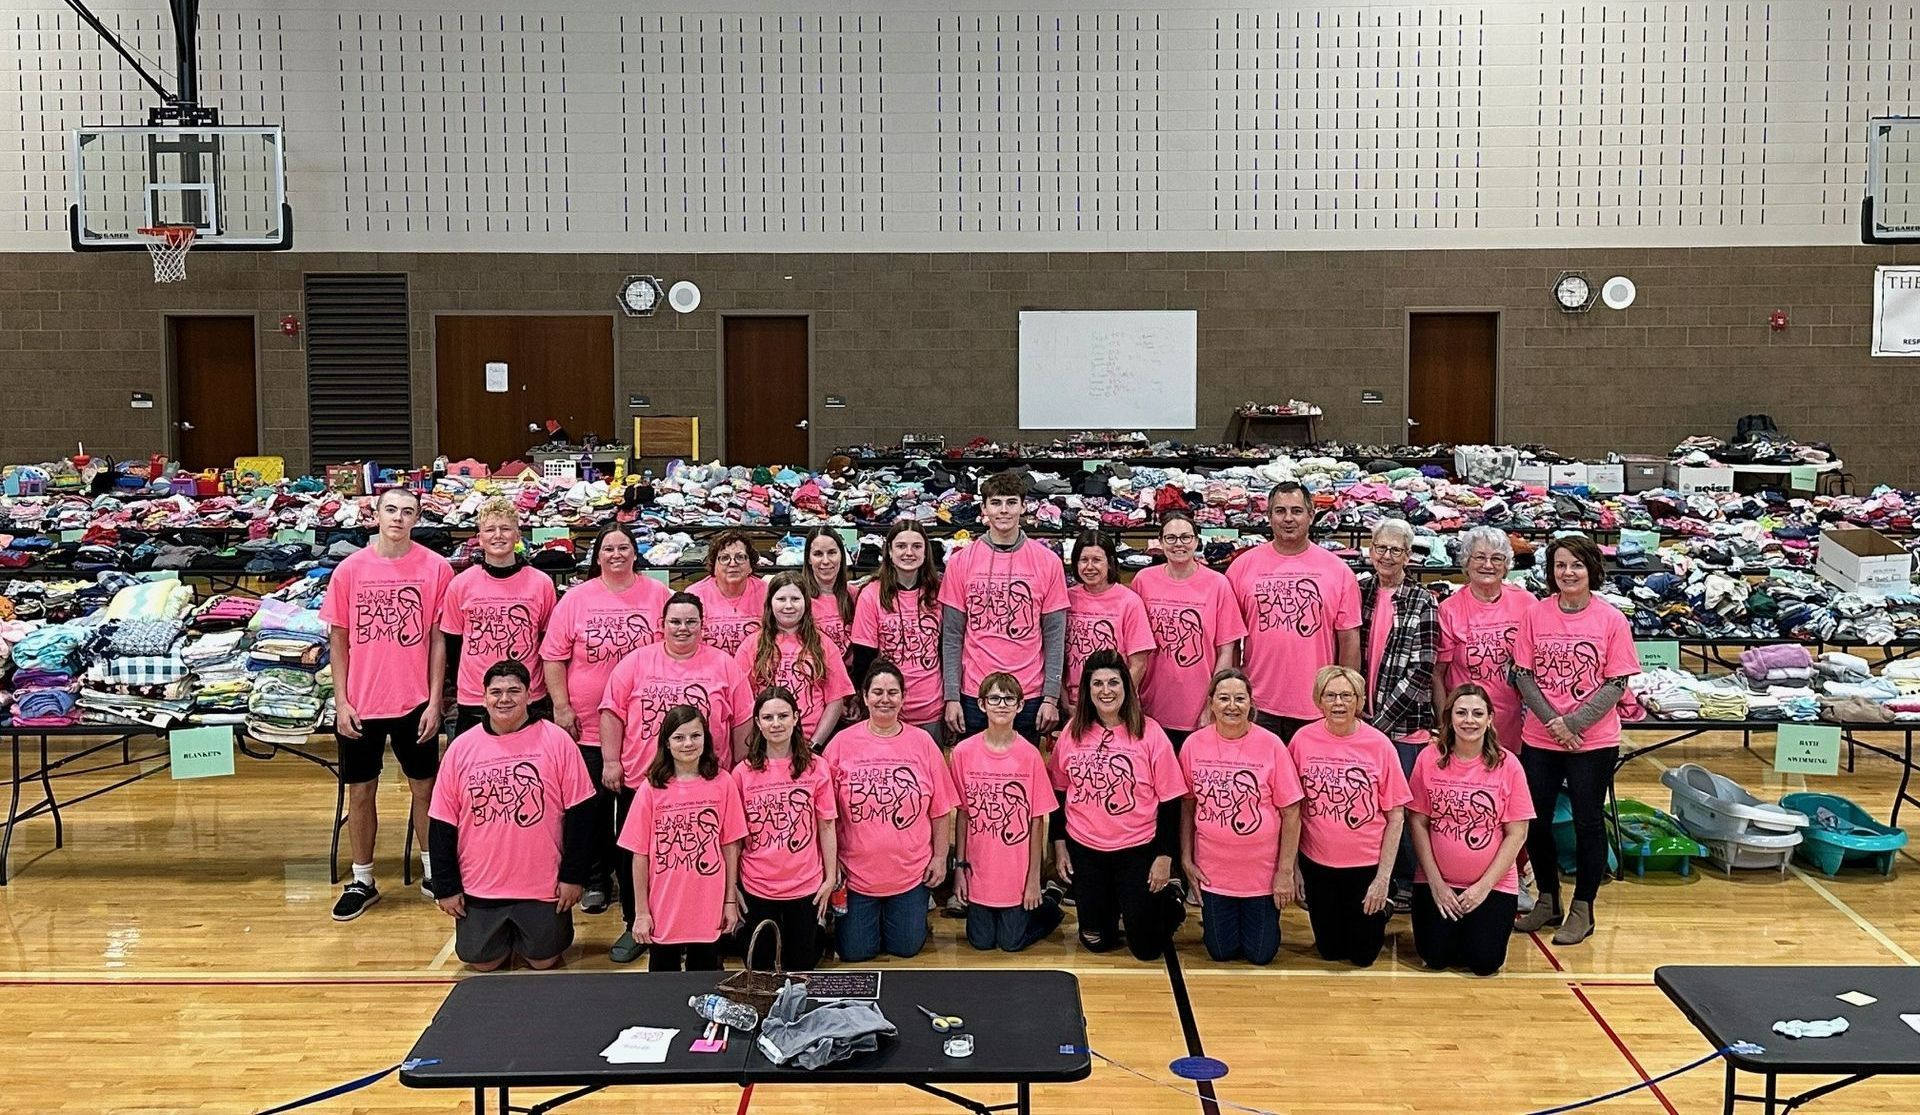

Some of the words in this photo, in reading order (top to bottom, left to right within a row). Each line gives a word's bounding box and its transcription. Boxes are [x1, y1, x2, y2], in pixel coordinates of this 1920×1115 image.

[357, 589, 398, 603] BUNDLE
[1256, 580, 1298, 593] BUNDLE
[469, 607, 509, 620] BUNDLE
[969, 595, 1020, 616] BABY
[1149, 607, 1179, 619] UNDLE
[1255, 594, 1307, 614] BABY
[356, 604, 410, 627] BABY
[586, 616, 628, 629] BUNDLE
[969, 617, 1010, 634] BUMP
[1258, 612, 1300, 632] BUMP
[356, 625, 401, 644] BUMP
[470, 620, 519, 641] BABY
[585, 629, 638, 649] BABY
[1154, 622, 1190, 642] ABY
[1466, 630, 1504, 642] BUNDLE
[467, 640, 509, 658] BUMP
[881, 632, 930, 652] BABY
[1534, 656, 1585, 679] BABY
[643, 685, 685, 698] BUNDLE
[184, 751, 222, 759] BLANKETS
[469, 766, 514, 785] BUNDLE
[850, 768, 893, 781] BUNDLE
[1069, 767, 1119, 789] BABY
[1192, 770, 1234, 783] BUNDLE
[1302, 765, 1345, 779] BUNDLE
[468, 784, 527, 809] BABY
[849, 783, 907, 806] BABY
[1071, 788, 1110, 807] BUMP
[1193, 783, 1246, 808] BABY
[1301, 775, 1358, 804] BABY
[1427, 788, 1470, 802] BUNDLE
[746, 792, 790, 808] BUNDLE
[966, 796, 1016, 820] BABY
[472, 803, 516, 827] BUMP
[655, 812, 697, 829] BUNDLE
[849, 805, 896, 824] BUMP
[1198, 805, 1234, 828] BUMP
[1307, 799, 1349, 823] BUMP
[746, 810, 802, 836] BABY
[969, 819, 1005, 838] BUMP
[655, 831, 710, 856] BABY
[749, 830, 792, 851] BUMP
[655, 851, 699, 875] BUMP
